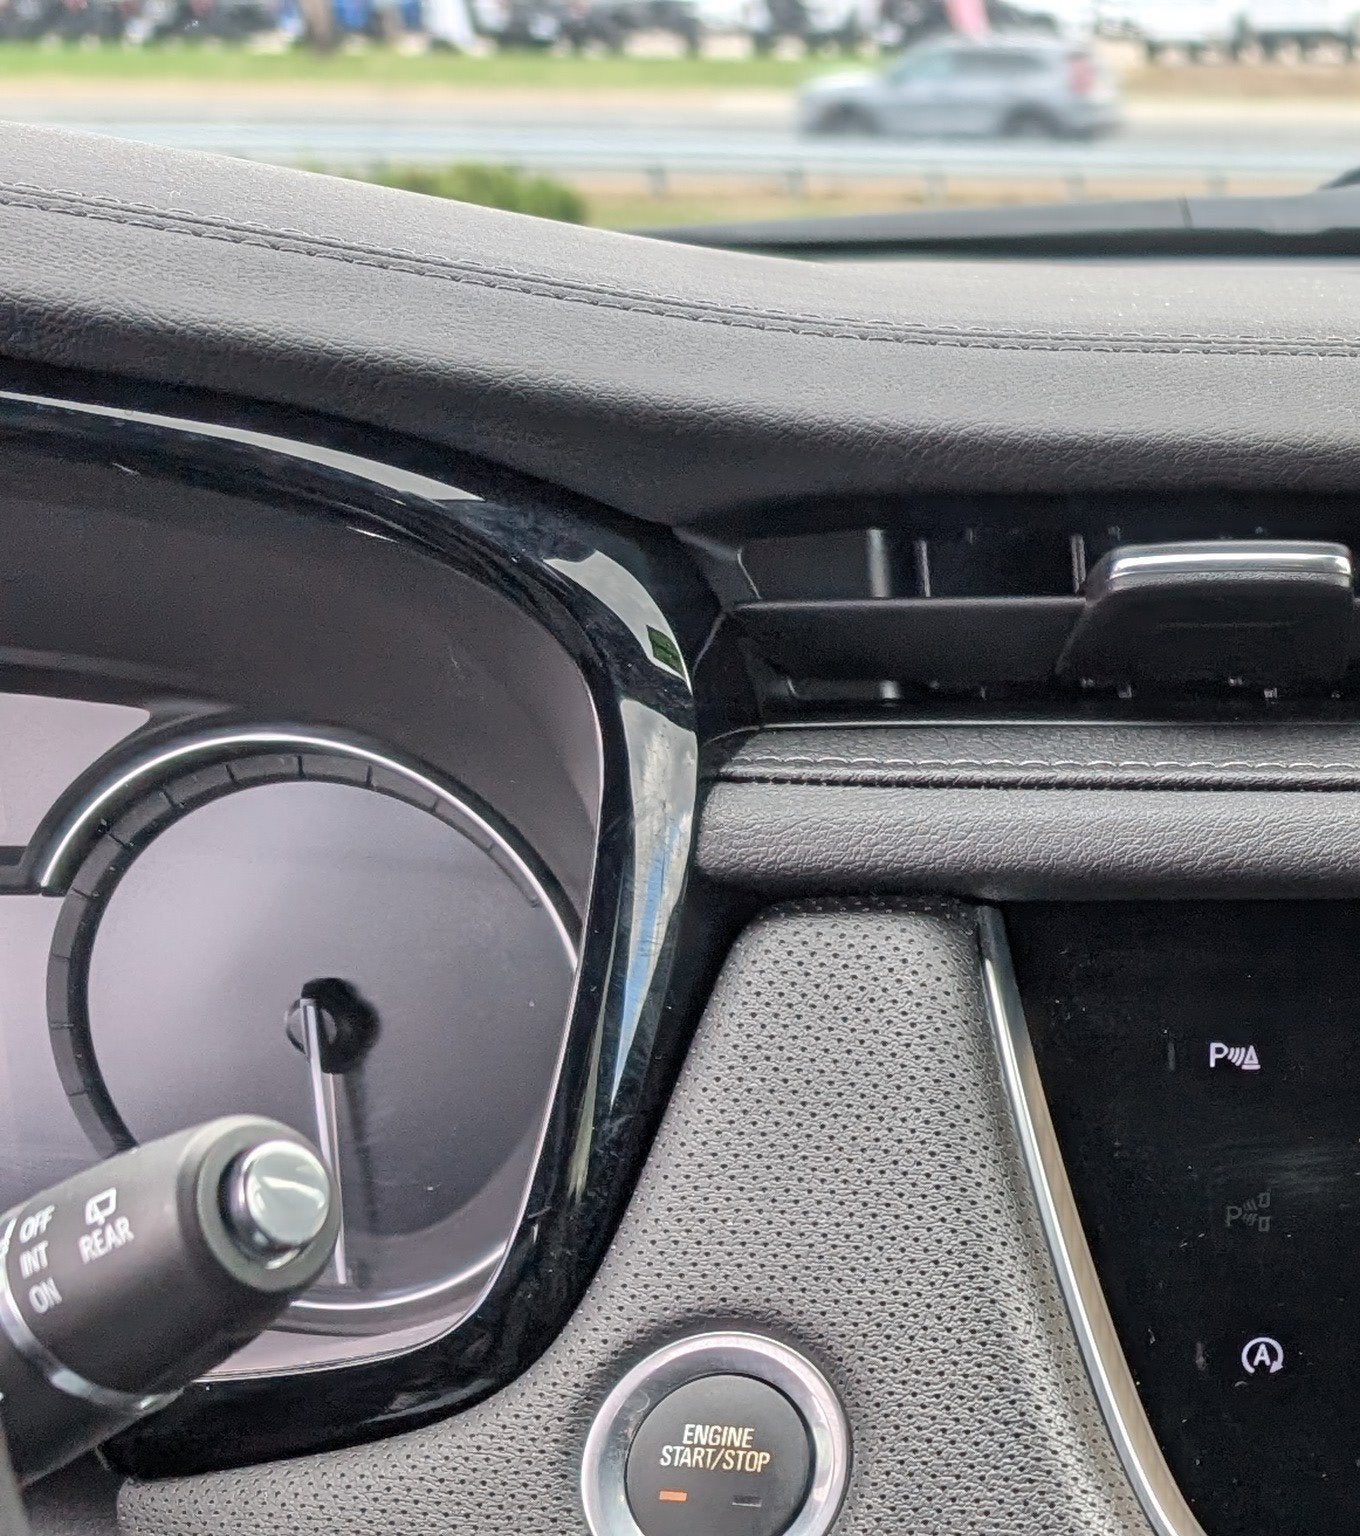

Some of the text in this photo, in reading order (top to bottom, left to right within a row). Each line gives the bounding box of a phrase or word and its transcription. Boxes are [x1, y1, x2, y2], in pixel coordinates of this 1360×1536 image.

[19, 1205, 56, 1243] OFF
[78, 1216, 135, 1263] REAR
[19, 1240, 50, 1280] INT
[28, 1277, 62, 1314] ON
[682, 1424, 755, 1449] ENGINE
[659, 1445, 771, 1473] START/STOP
